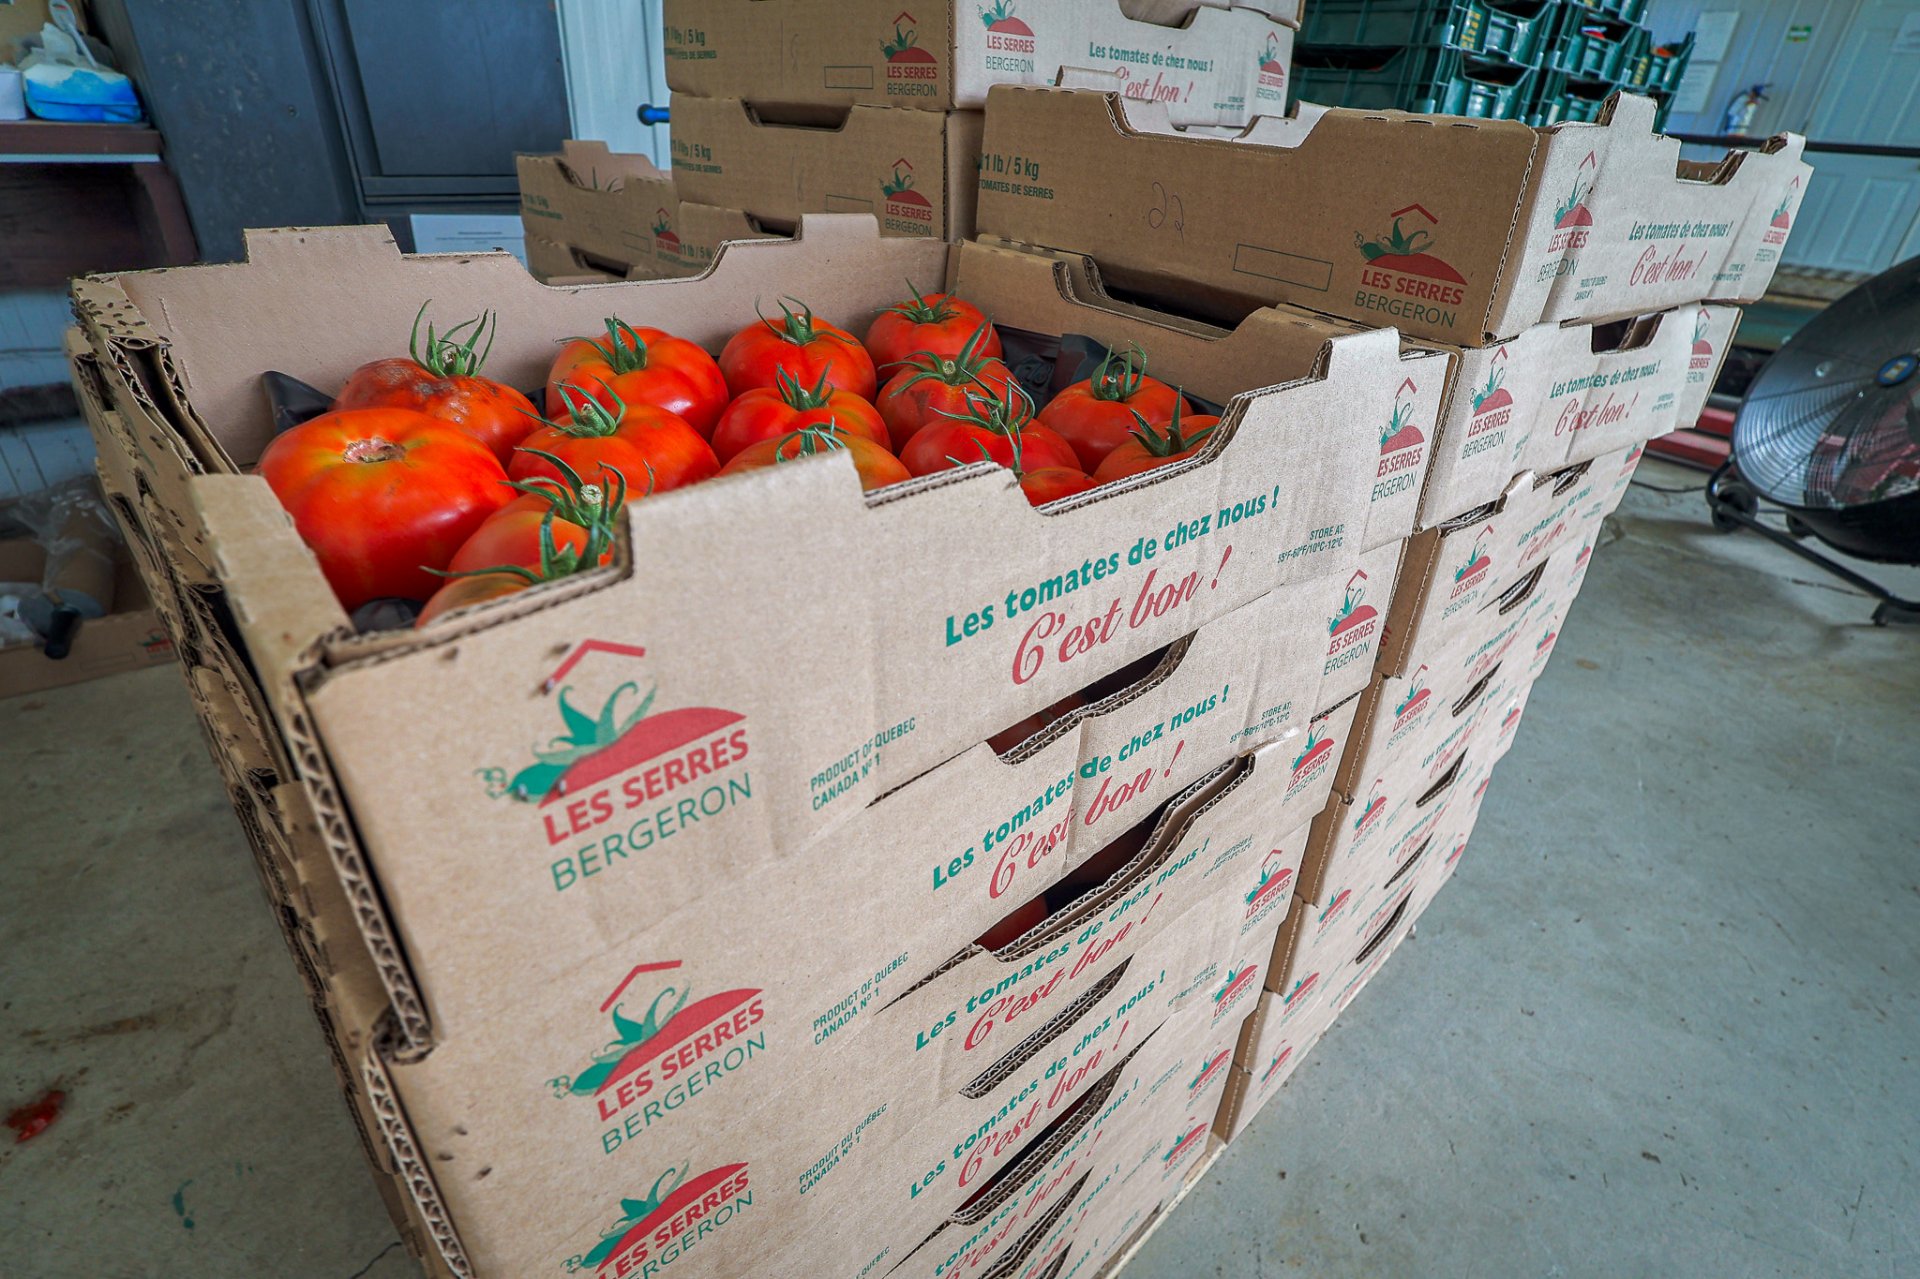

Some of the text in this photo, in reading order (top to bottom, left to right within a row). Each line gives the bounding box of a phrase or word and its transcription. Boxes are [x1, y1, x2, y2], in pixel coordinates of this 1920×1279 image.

[986, 34, 1035, 54] LES SERRES
[1089, 42, 1106, 59] Les
[1108, 45, 1150, 65] tomates
[1152, 49, 1164, 66] de
[1165, 53, 1185, 70] chez
[1186, 57, 1208, 72] nous
[887, 66, 937, 80] LES SERRES
[985, 55, 1034, 73] BERGERON
[887, 83, 937, 97] BERGERON
[993, 154, 1004, 173] lb
[1014, 157, 1022, 175] 5
[1025, 158, 1039, 181] kg
[1011, 183, 1022, 195] DE
[1023, 185, 1054, 200] SERRES
[885, 218, 932, 236] BERGERON
[886, 203, 932, 222] LES SERRES
[1628, 221, 1646, 241] Les
[1647, 221, 1682, 240] tomates
[1680, 221, 1691, 239] de
[1361, 269, 1464, 306] LES SERRES
[1354, 291, 1457, 328] BERGERON
[1550, 380, 1566, 399] Les
[1610, 371, 1620, 388] de
[1468, 408, 1512, 438] LES SERRES
[1377, 447, 1423, 478] ES SERRES
[1462, 429, 1507, 460] BERGERON
[1371, 471, 1418, 503] ERGERON
[1309, 526, 1335, 541] STORE
[945, 602, 995, 648] Les
[1004, 551, 1120, 619] tomates
[1127, 536, 1157, 566] de
[1163, 513, 1212, 551] chez
[1216, 494, 1267, 530] nous
[1011, 598, 1124, 686] C'est
[1128, 568, 1205, 630] bon
[1326, 619, 1377, 658] ES SERRES
[1323, 640, 1371, 676] ERGERON
[810, 716, 917, 793] PRODUCT OF QUEBEC
[542, 729, 750, 847] LES SERRES
[812, 770, 860, 812] CANADA
[874, 752, 881, 767] 1
[932, 846, 975, 891] Les
[982, 769, 1075, 853] tomates
[1079, 755, 1111, 780] de
[1118, 727, 1163, 763] chez
[1169, 694, 1218, 733] nous
[550, 772, 752, 892] BERGERON
[989, 808, 1076, 900] C'est
[1084, 767, 1158, 827] bon
[915, 1009, 958, 1052] Les
[965, 940, 1070, 1015] tomates
[1076, 919, 1104, 946] de
[1108, 883, 1153, 923] chez
[1155, 852, 1199, 888] nous
[812, 950, 909, 1032] PRODUCT OF QUEBEC
[963, 967, 1067, 1052] C'est
[1068, 920, 1137, 981] bon
[814, 1005, 859, 1046] CANADA
[873, 986, 880, 998] 1
[597, 998, 766, 1123] LES SERRES
[601, 1030, 766, 1155] BERGERON
[909, 1159, 946, 1200] Les
[952, 1077, 1039, 1160] tomates
[1044, 1055, 1069, 1081] de
[1072, 1015, 1112, 1057] chez
[1115, 980, 1156, 1021] nous
[957, 1097, 1042, 1189] C'est
[1047, 1047, 1108, 1111] bon
[799, 1102, 889, 1186] PRODUIT DU QUÉBEC
[800, 1155, 841, 1196] CANADA
[934, 1197, 1020, 1277] tomates
[1025, 1172, 1047, 1197] de
[1051, 1128, 1091, 1170] chez
[1093, 1088, 1131, 1131] nous
[598, 1169, 750, 1279] ES SERRES
[860, 1245, 890, 1276] QUEBEC
